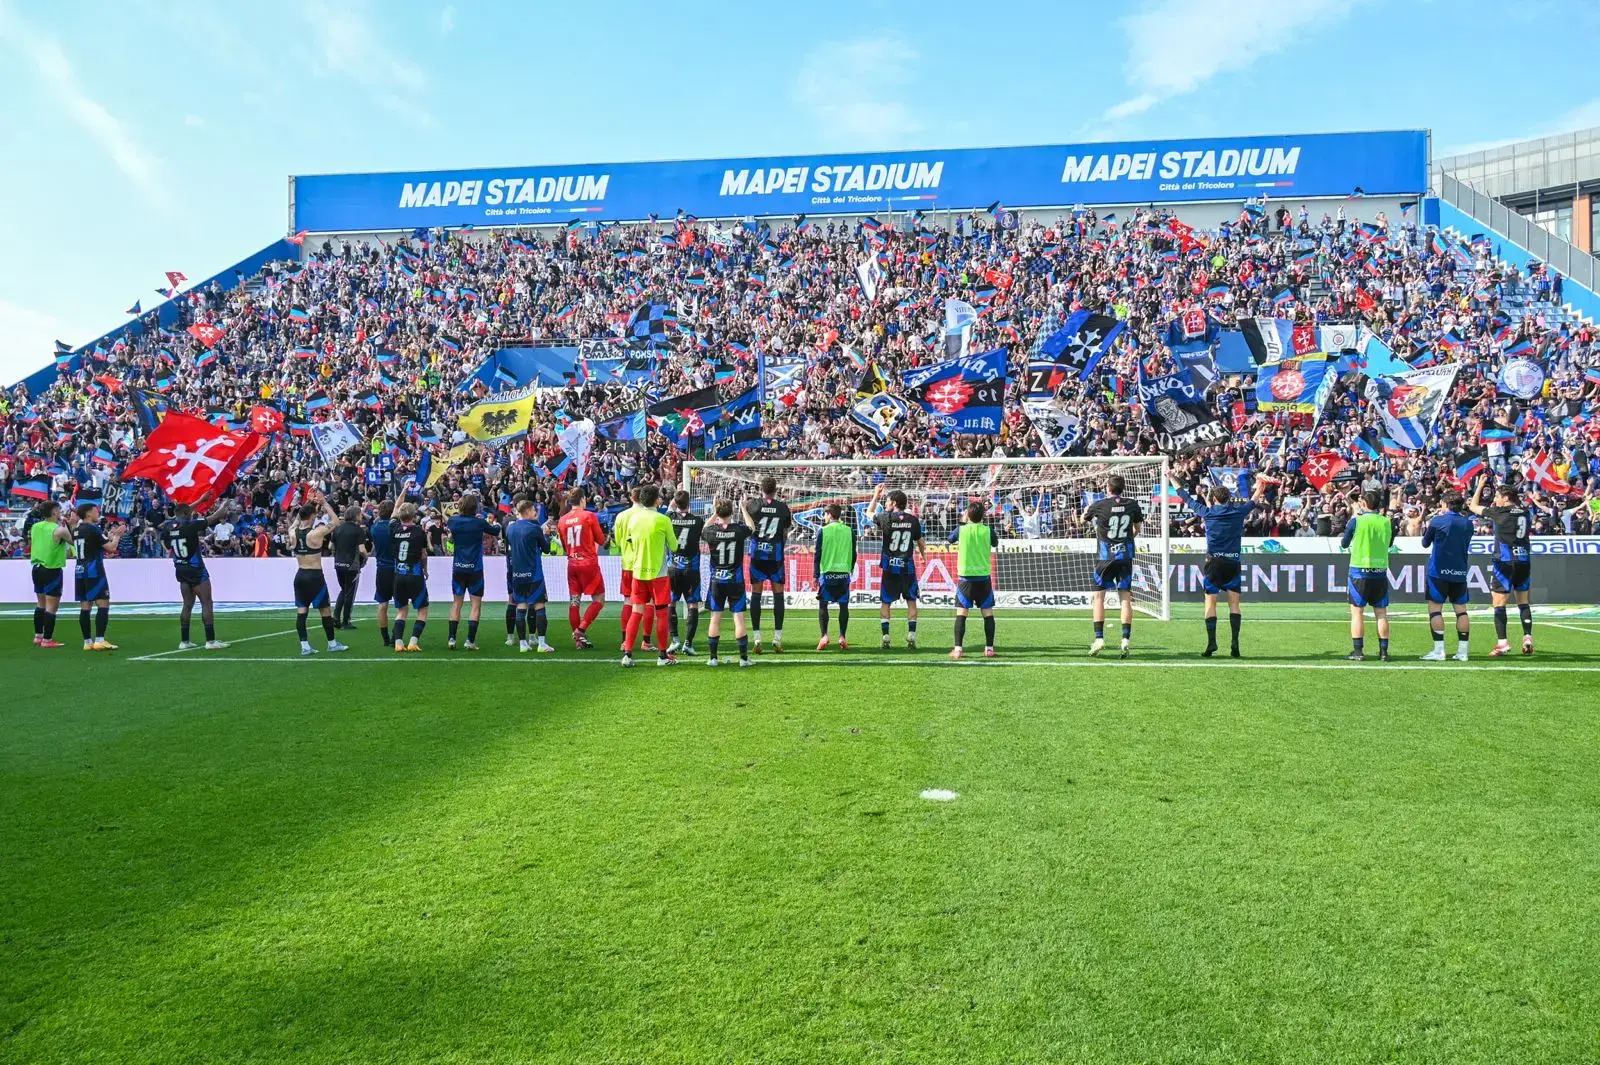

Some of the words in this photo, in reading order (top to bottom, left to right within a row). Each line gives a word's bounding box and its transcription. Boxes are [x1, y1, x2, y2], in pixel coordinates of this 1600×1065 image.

[1061, 152, 1157, 183] MAPEI
[1159, 147, 1301, 179] STADIUM
[719, 167, 809, 196] MAPEI
[811, 161, 945, 193] STADIUM
[1159, 182, 1180, 191] Città
[1182, 182, 1196, 190] del
[1198, 181, 1235, 189] Tricolore
[399, 180, 483, 208] MAPEI
[485, 174, 610, 205] STADIUM
[811, 196, 830, 204] Città
[847, 195, 883, 203] Tricolore
[519, 207, 552, 215] Tricolore
[630, 349, 673, 360] PONSAO
[1030, 371, 1044, 392] Z
[567, 524, 583, 548] 47
[758, 516, 780, 539] 14
[1107, 514, 1131, 539] 32
[1515, 516, 1527, 539] 3
[170, 538, 189, 558] 15
[677, 527, 690, 549] 4
[889, 530, 912, 552] 33
[398, 540, 410, 561] 8
[716, 541, 737, 565] 11
[1018, 594, 1088, 606] GoldBet
